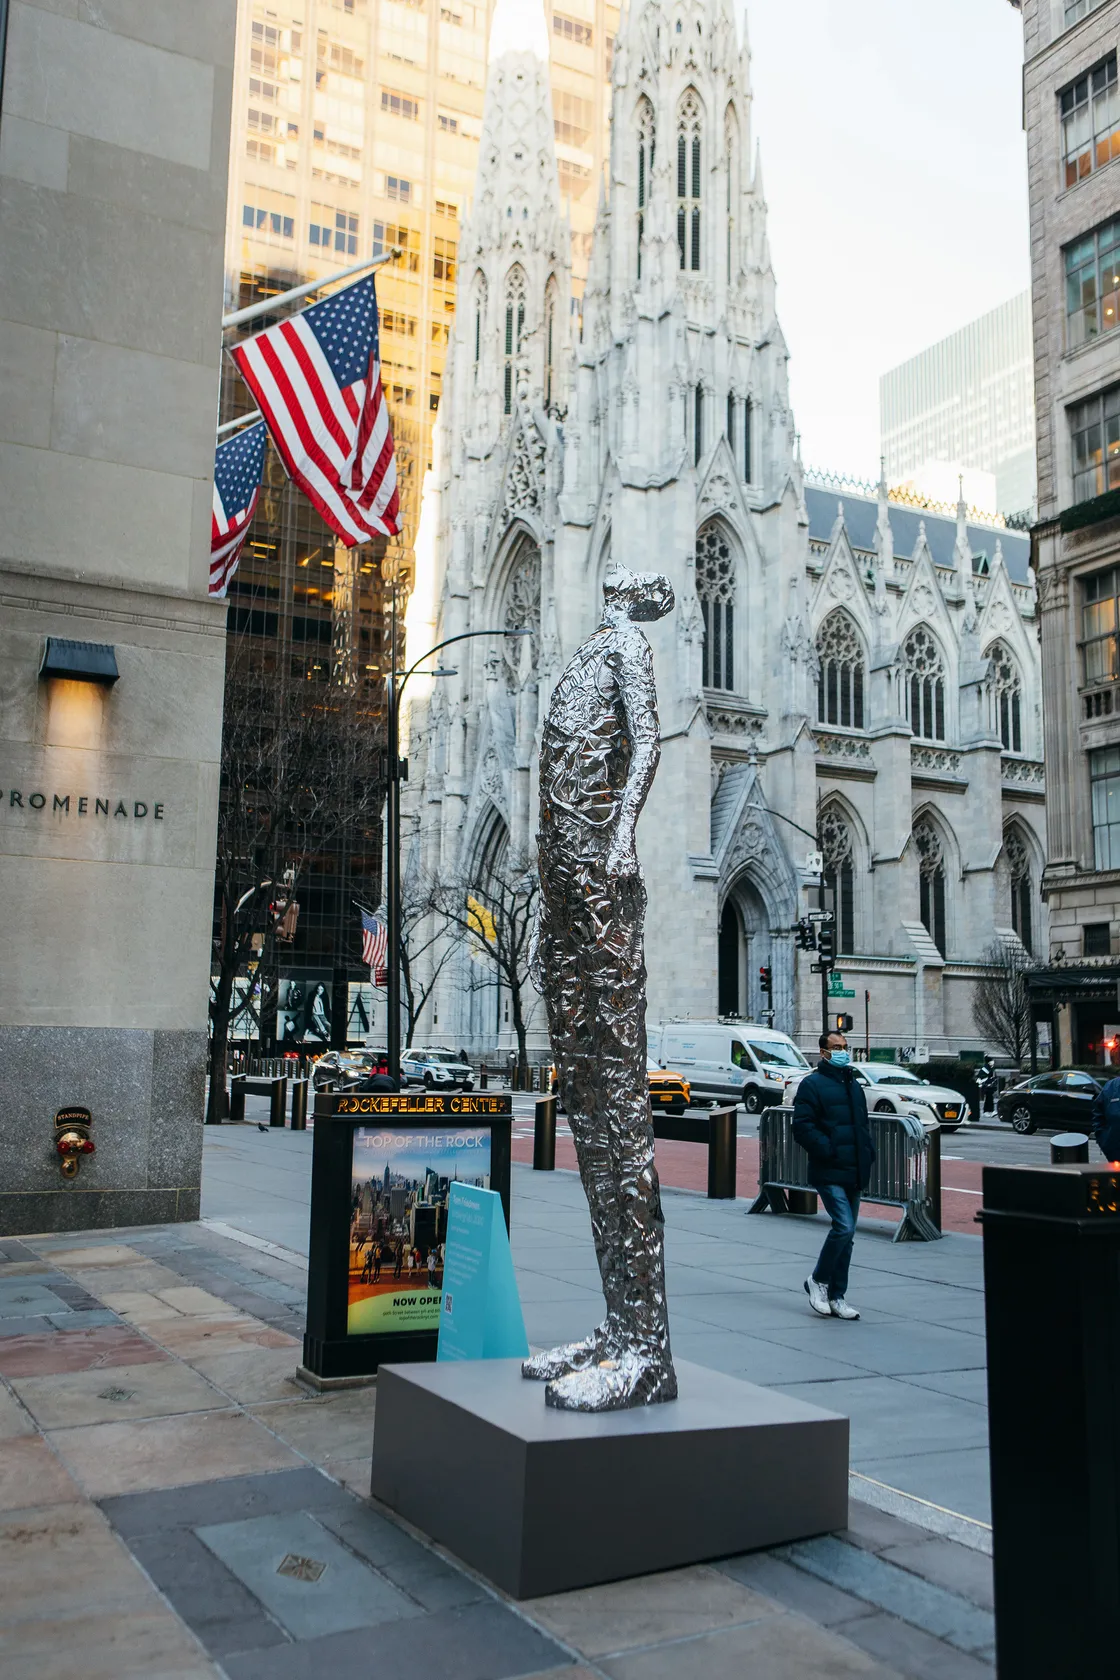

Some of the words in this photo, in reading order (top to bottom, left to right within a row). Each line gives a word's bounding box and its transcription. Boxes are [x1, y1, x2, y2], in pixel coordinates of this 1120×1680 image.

[0, 789, 164, 820] ROMENADE
[337, 1097, 445, 1113] ROCKEFELLER
[57, 1112, 89, 1121] STANDPIPE
[363, 1135, 392, 1148] TOP
[394, 1135, 414, 1148] OF
[416, 1135, 443, 1148] THE
[446, 1135, 484, 1148] ROCK
[393, 1297, 417, 1307] NOW
